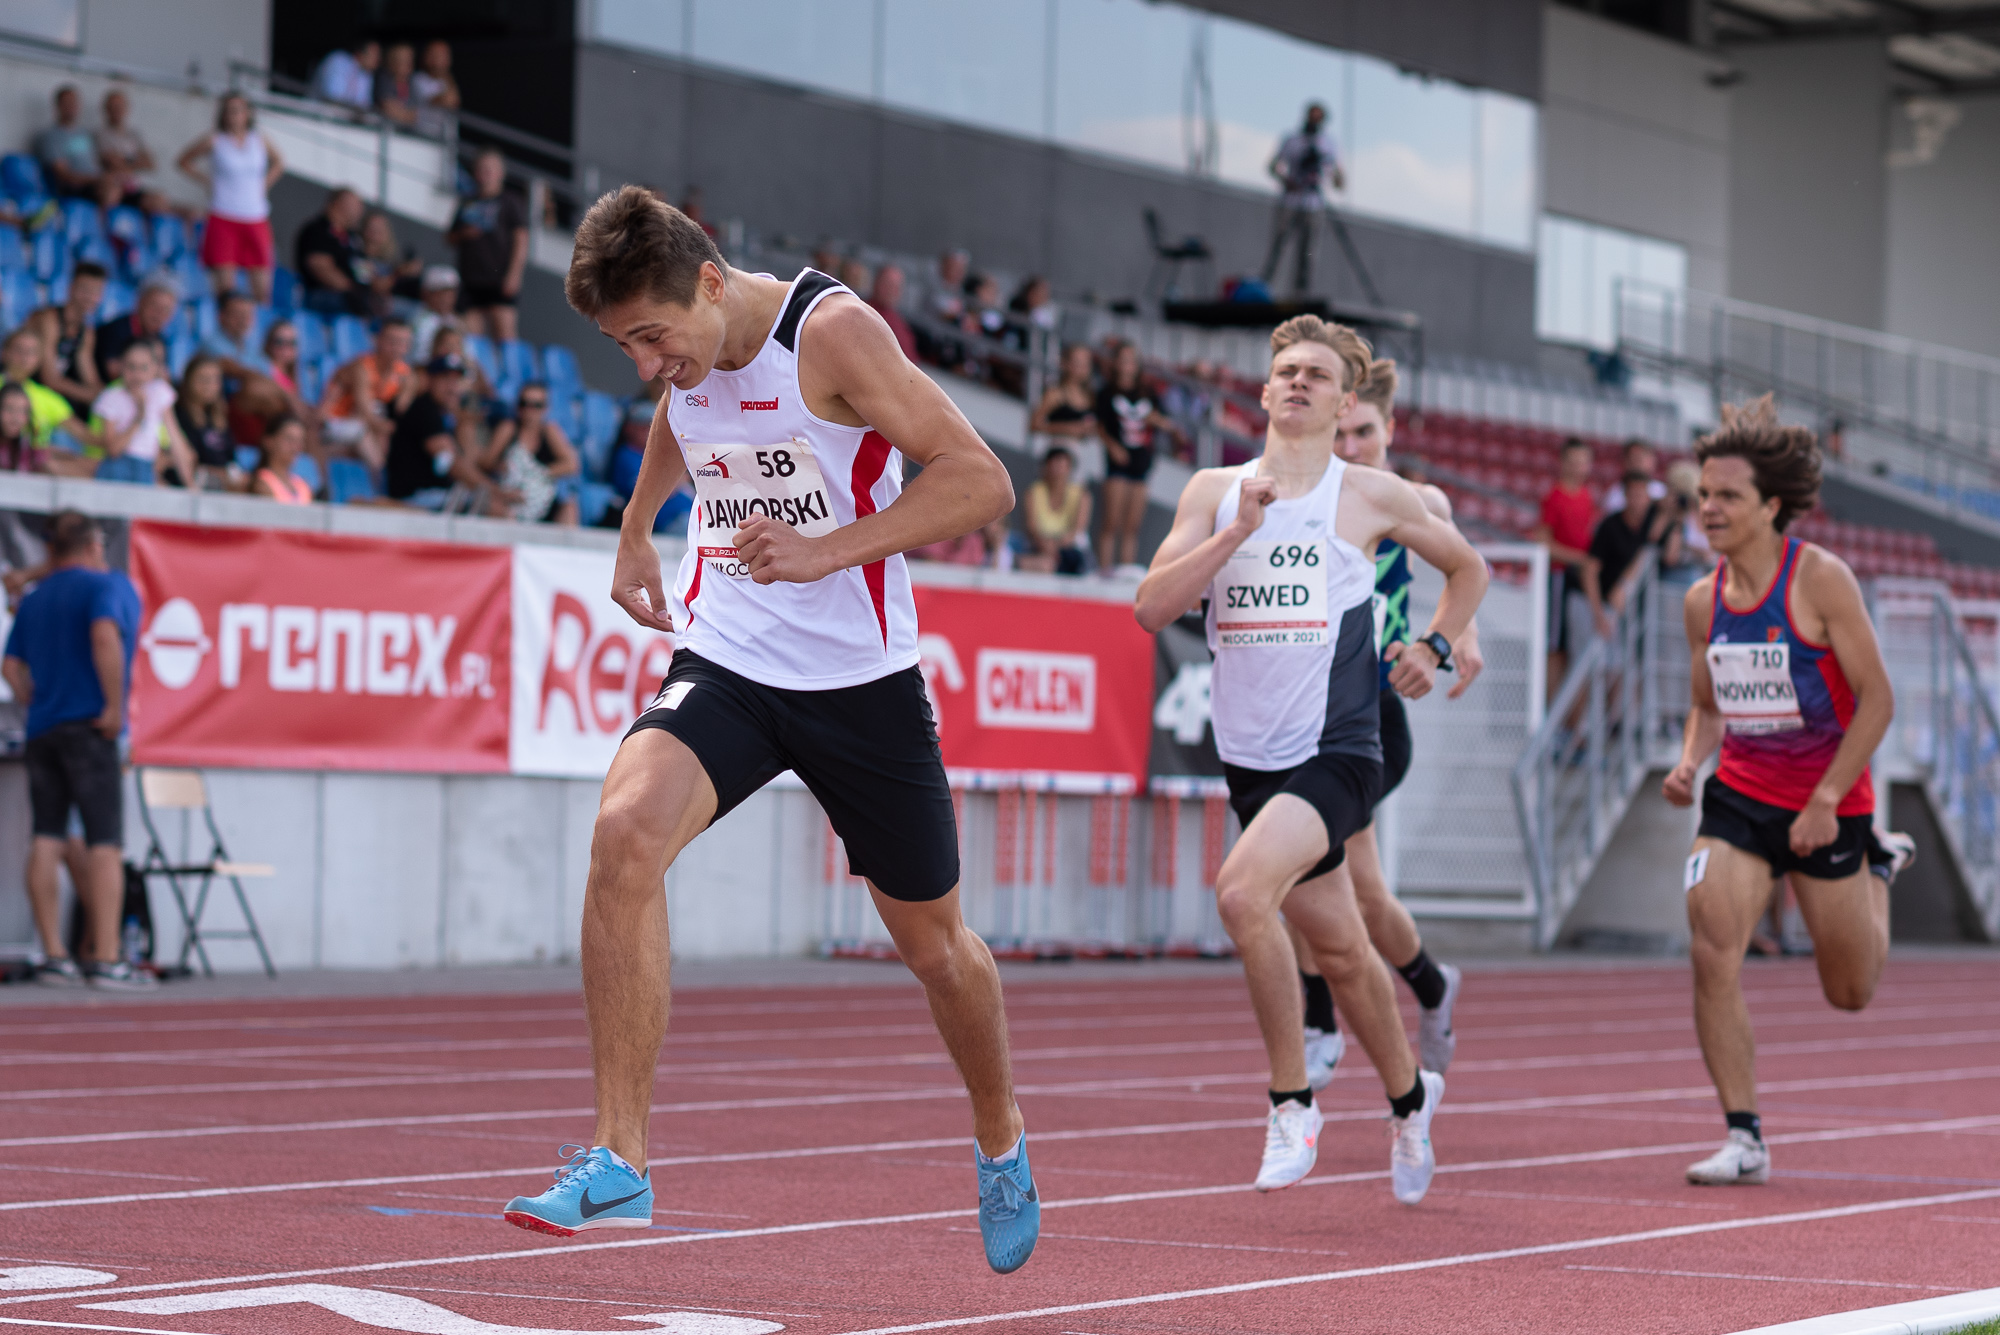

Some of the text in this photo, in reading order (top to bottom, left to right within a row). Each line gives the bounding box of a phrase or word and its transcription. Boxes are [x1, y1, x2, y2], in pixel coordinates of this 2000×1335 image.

[685, 393, 710, 408] esa
[696, 467, 721, 478] polanik
[755, 449, 796, 478] 58
[706, 490, 828, 528] JAWORSKI
[1269, 545, 1319, 568] 696
[1227, 585, 1310, 608] SZWED
[1293, 632, 1321, 643] 2021
[1751, 650, 1783, 669] 710
[1716, 681, 1793, 701] NOWICKI
[1691, 856, 1702, 882] 1
